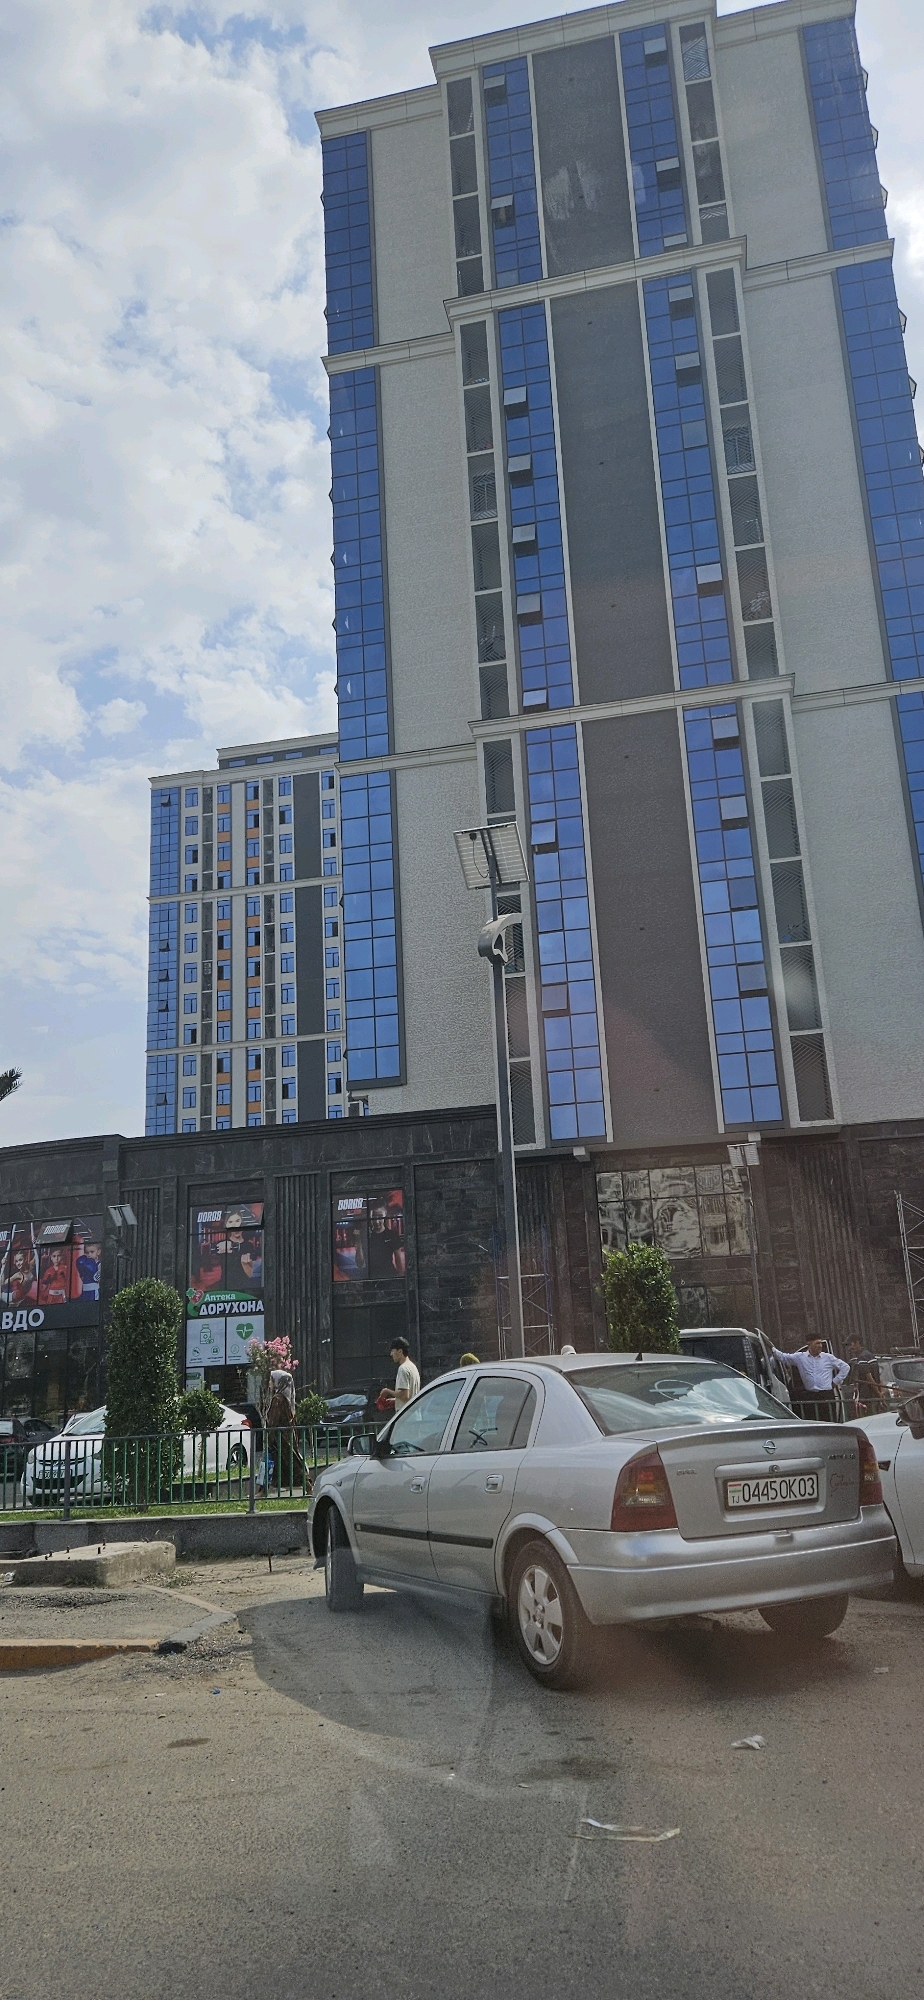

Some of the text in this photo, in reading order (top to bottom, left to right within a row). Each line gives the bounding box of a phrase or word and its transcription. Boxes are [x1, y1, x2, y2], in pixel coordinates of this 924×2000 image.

[204, 1293, 236, 1302] Аптека
[199, 1300, 264, 1316] ДОРУХОНА
[0, 1308, 45, 1332] ВДО
[731, 1495, 740, 1504] TJ
